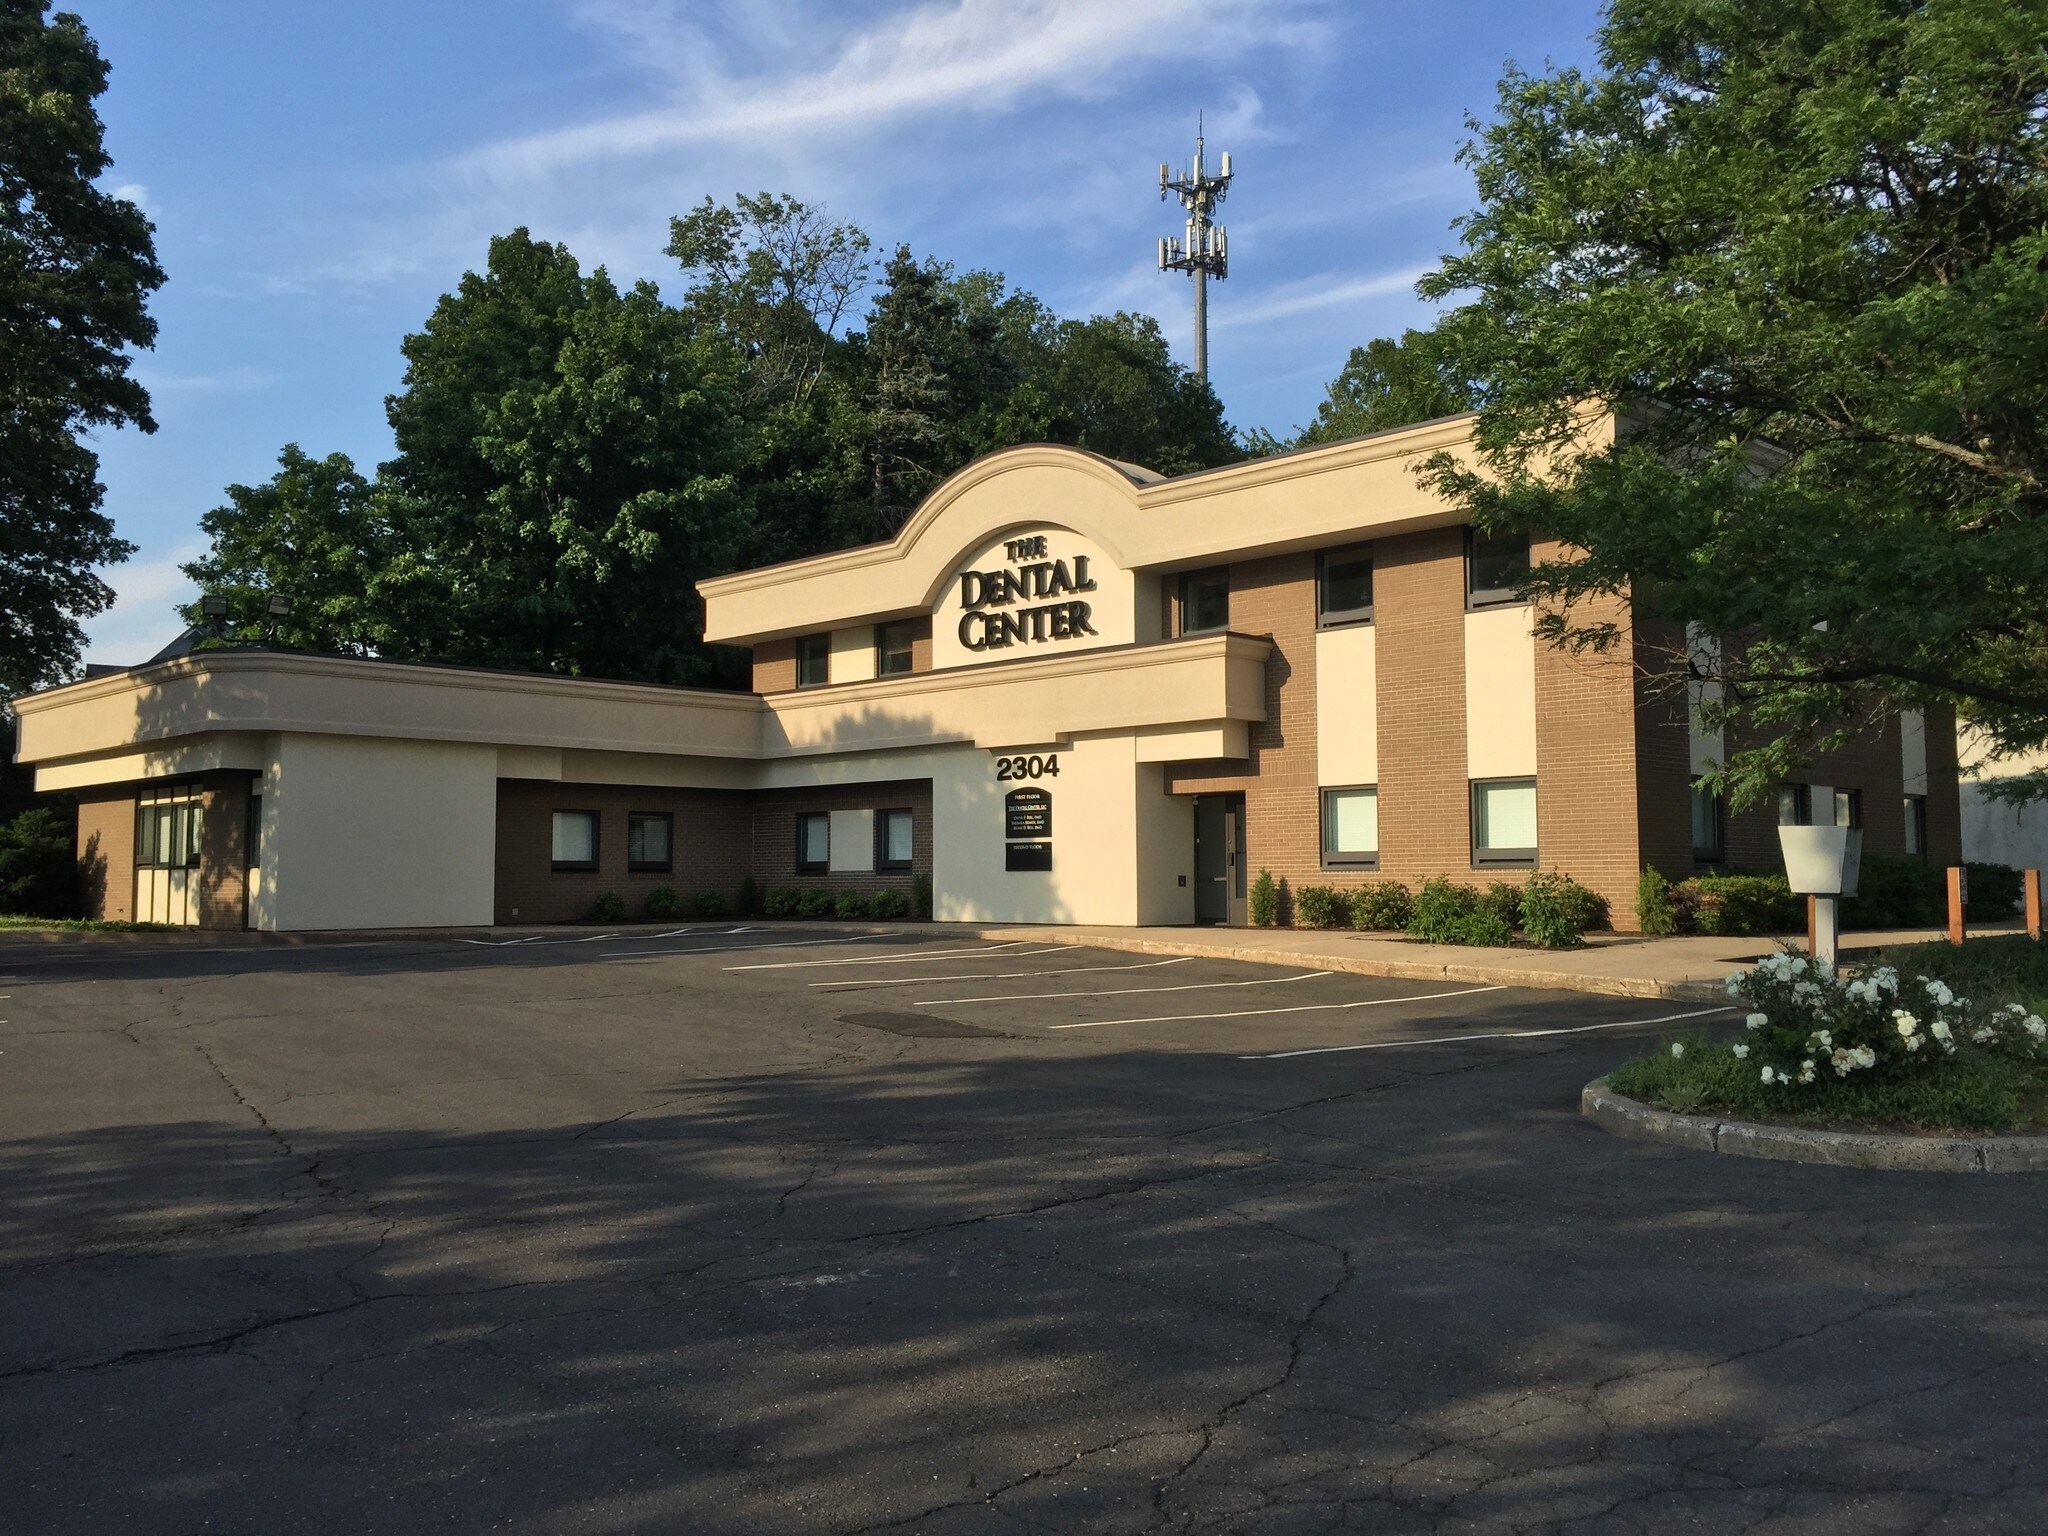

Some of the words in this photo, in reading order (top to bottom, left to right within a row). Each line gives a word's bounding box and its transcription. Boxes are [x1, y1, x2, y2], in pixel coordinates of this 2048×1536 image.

[1003, 535, 1048, 563] THE
[959, 555, 1097, 611] DENTAL
[958, 600, 1099, 652] CENTER
[996, 754, 1060, 781] 2304
